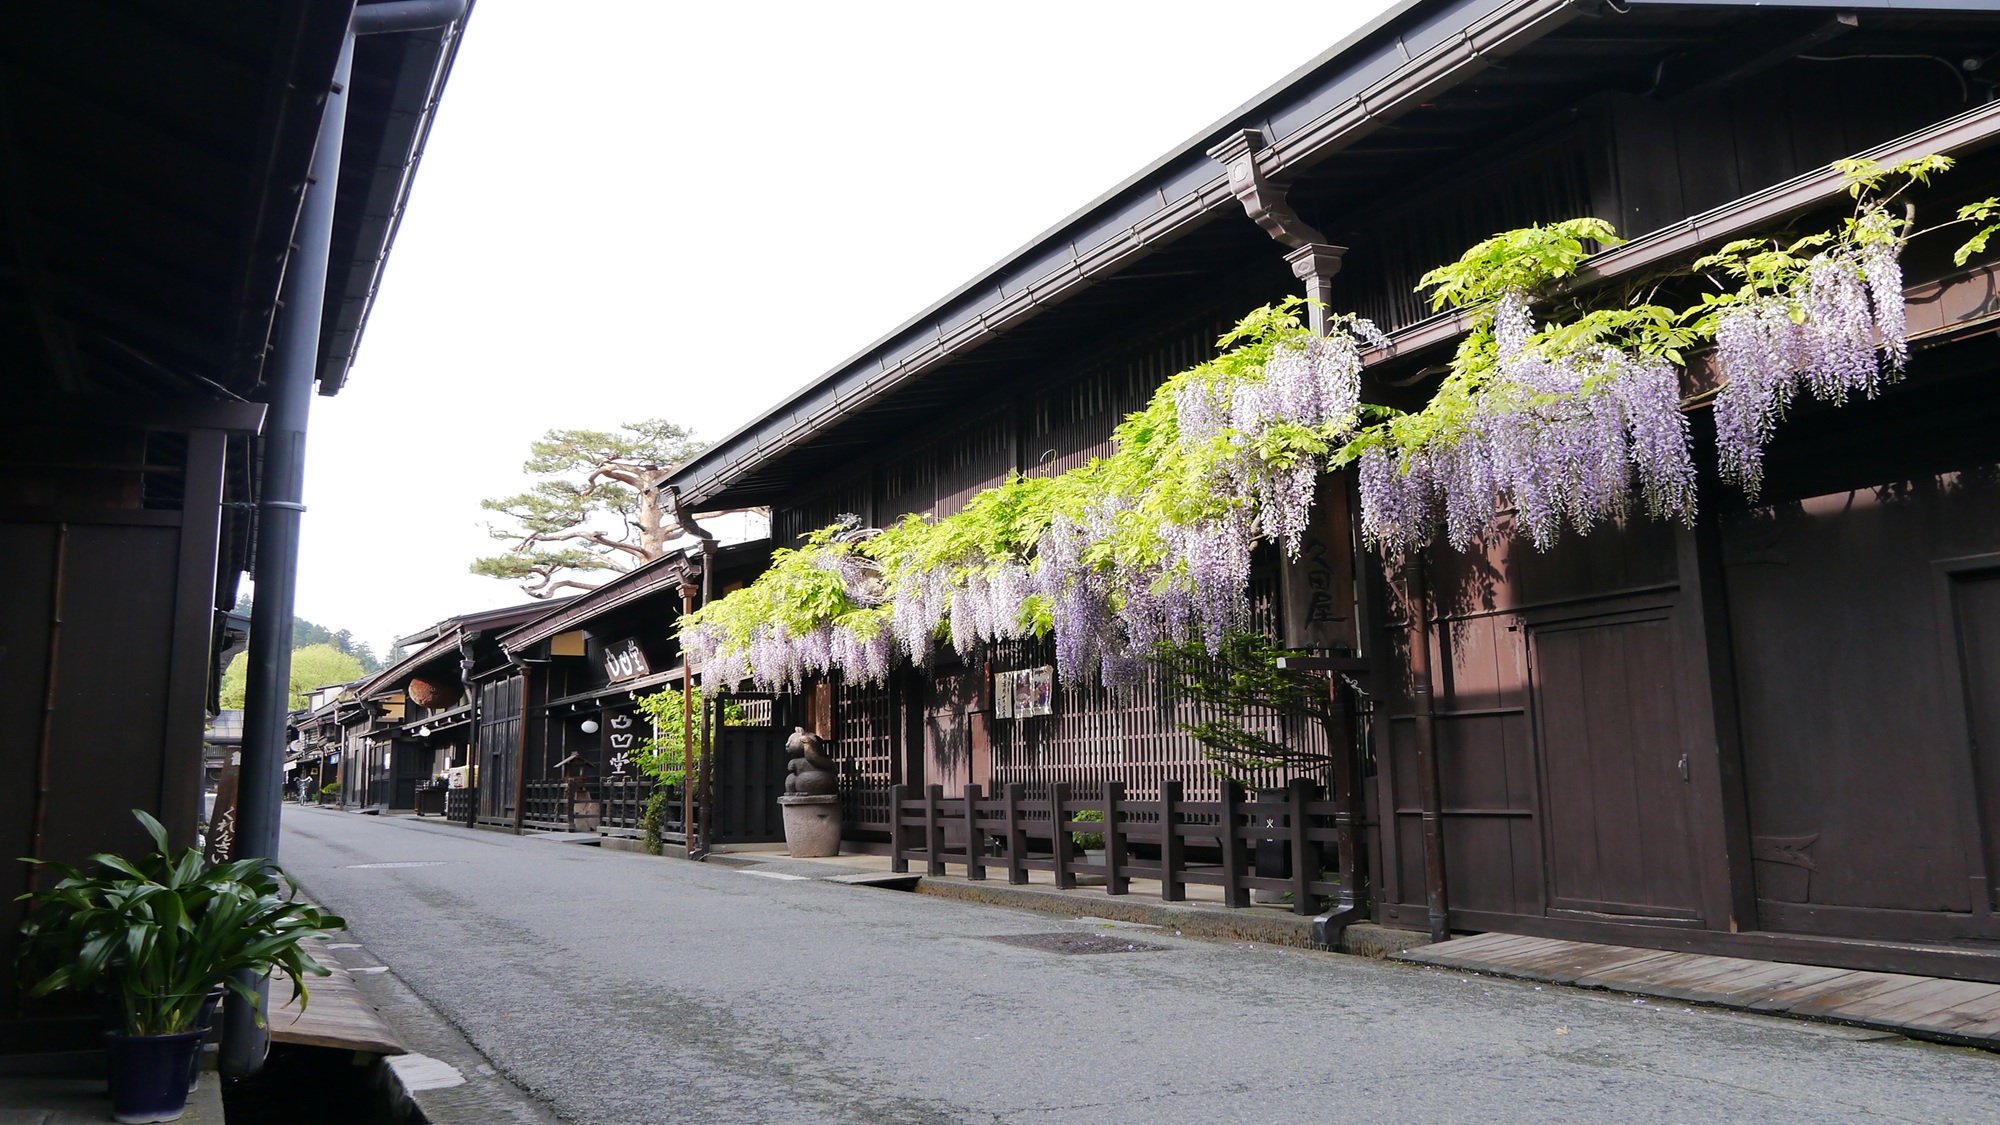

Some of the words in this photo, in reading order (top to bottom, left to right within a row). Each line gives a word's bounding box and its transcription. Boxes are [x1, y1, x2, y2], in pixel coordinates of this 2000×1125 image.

[1305, 538, 1347, 629] 久田屋
[605, 639, 644, 676] 凸凹堂
[609, 715, 633, 774] 凸凹堂
